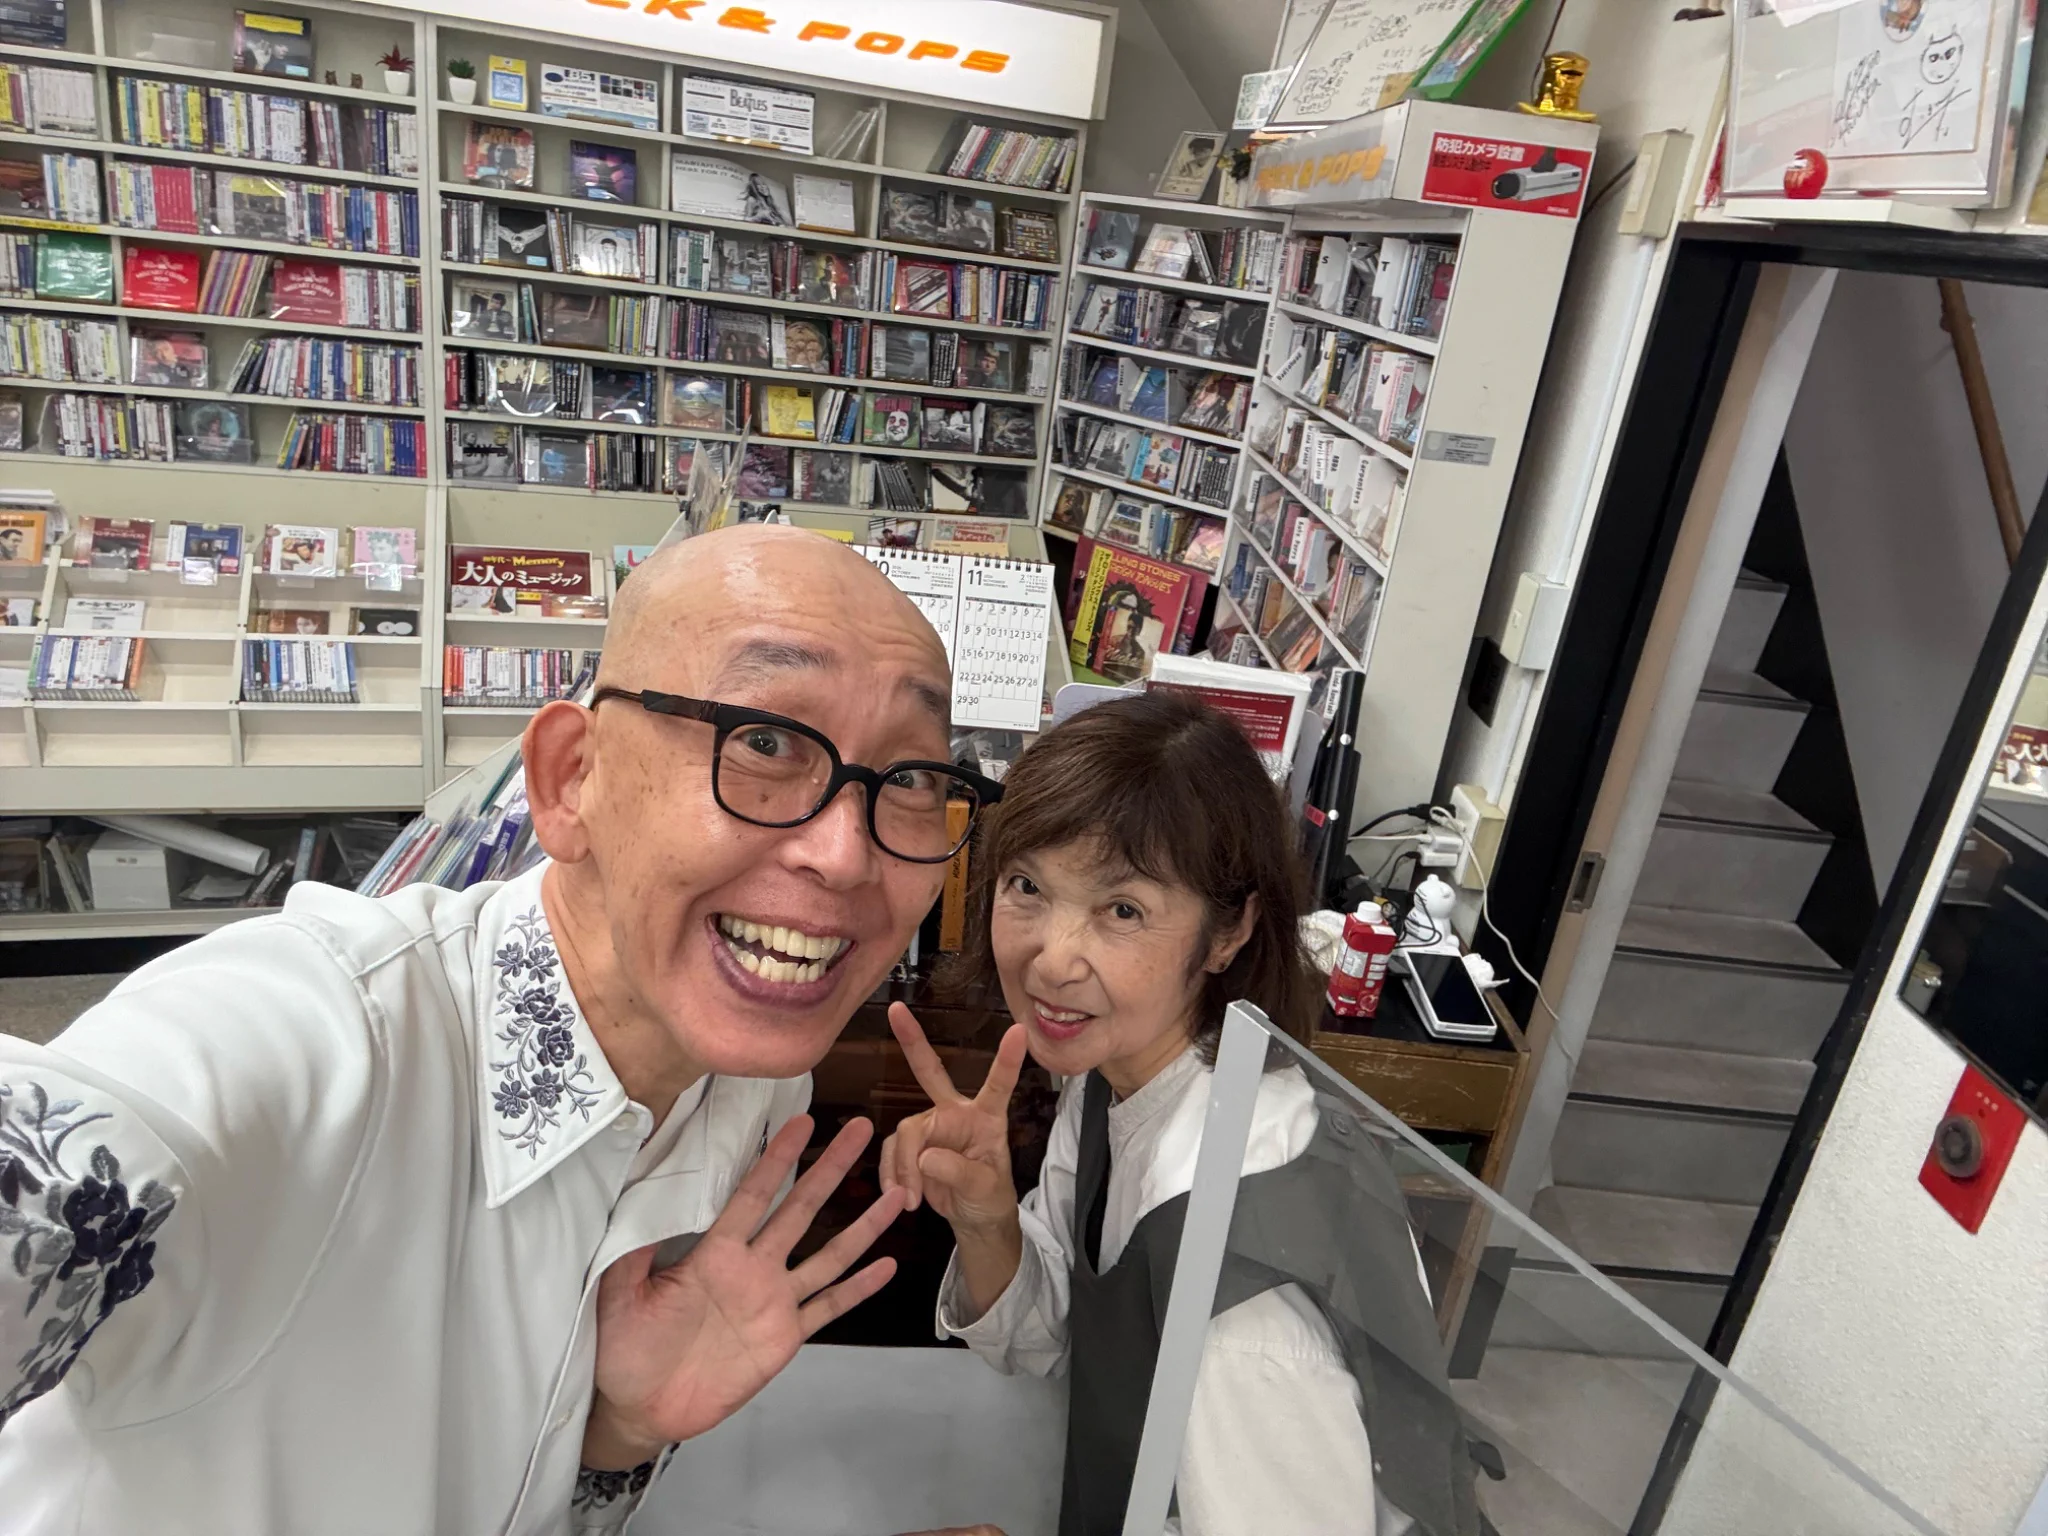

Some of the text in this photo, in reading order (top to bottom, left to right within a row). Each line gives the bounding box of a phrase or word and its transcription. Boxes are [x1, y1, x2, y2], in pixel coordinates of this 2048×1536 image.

[717, 6, 777, 34] &
[797, 20, 1011, 74] POPS
[730, 88, 768, 112] BEATLES
[1434, 136, 1525, 163] 防犯カメラ設置
[1315, 143, 1388, 186] POPS
[1321, 255, 1330, 264] S
[1381, 261, 1390, 272] T
[1381, 374, 1390, 384] V
[1353, 459, 1369, 505] Carpenters
[512, 555, 565, 568] Memory
[458, 561, 583, 586] 大人のミュージック
[967, 569, 983, 586] 11
[1139, 562, 1182, 582] STONES
[965, 602, 971, 611] 1
[977, 603, 984, 612] 2
[988, 603, 996, 614] 3
[1000, 605, 1007, 614] 4
[1012, 606, 1018, 616] 5
[1023, 607, 1030, 617] 6
[1034, 608, 1042, 618] 7
[938, 623, 950, 633] 10
[963, 625, 1043, 642] 8 9 10 11 12 13 14
[962, 649, 1040, 665] 15 16 17 18 19 20 21
[959, 672, 1038, 688] 22 23 24 25 26 27 28
[957, 695, 979, 706] 29 30
